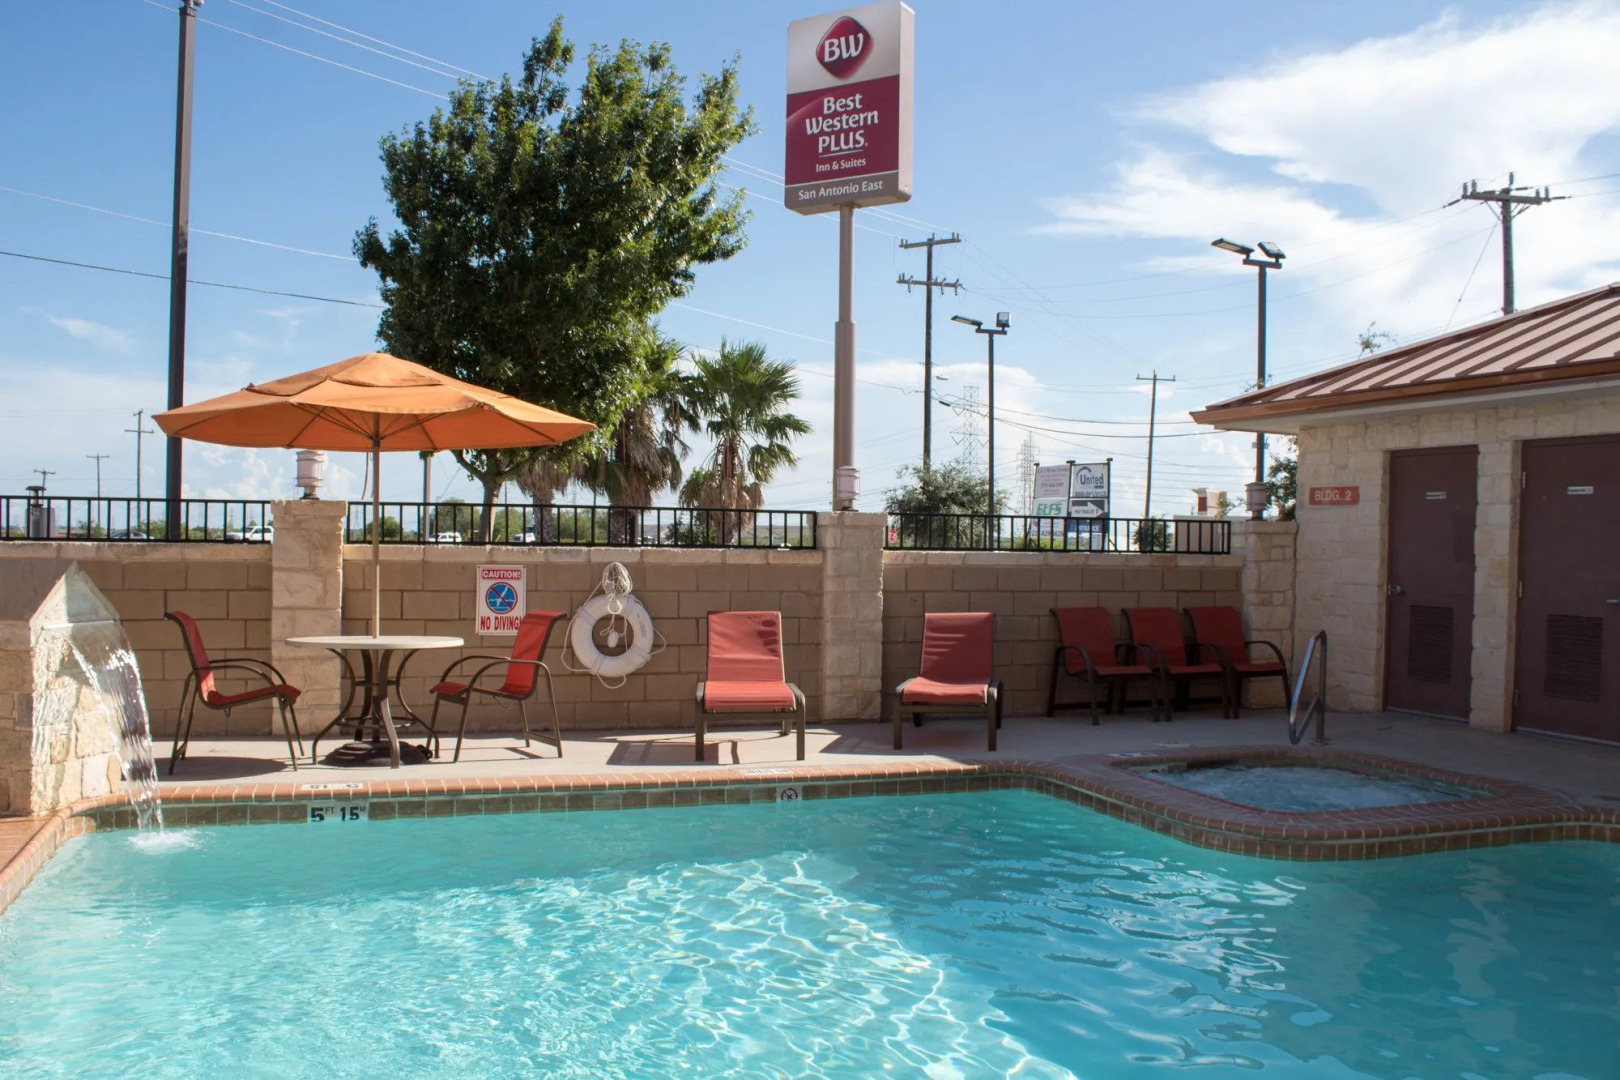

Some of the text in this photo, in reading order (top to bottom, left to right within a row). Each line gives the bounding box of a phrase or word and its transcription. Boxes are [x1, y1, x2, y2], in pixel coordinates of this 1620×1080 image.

[823, 32, 865, 63] BW
[823, 92, 863, 115] Best
[805, 110, 879, 135] Western
[815, 157, 866, 173] Inn & Suites
[798, 179, 883, 201] San Antonio East
[1080, 474, 1103, 485] United
[1345, 490, 1352, 500] 2
[483, 570, 520, 578] CAUTION!
[480, 616, 491, 630] NO
